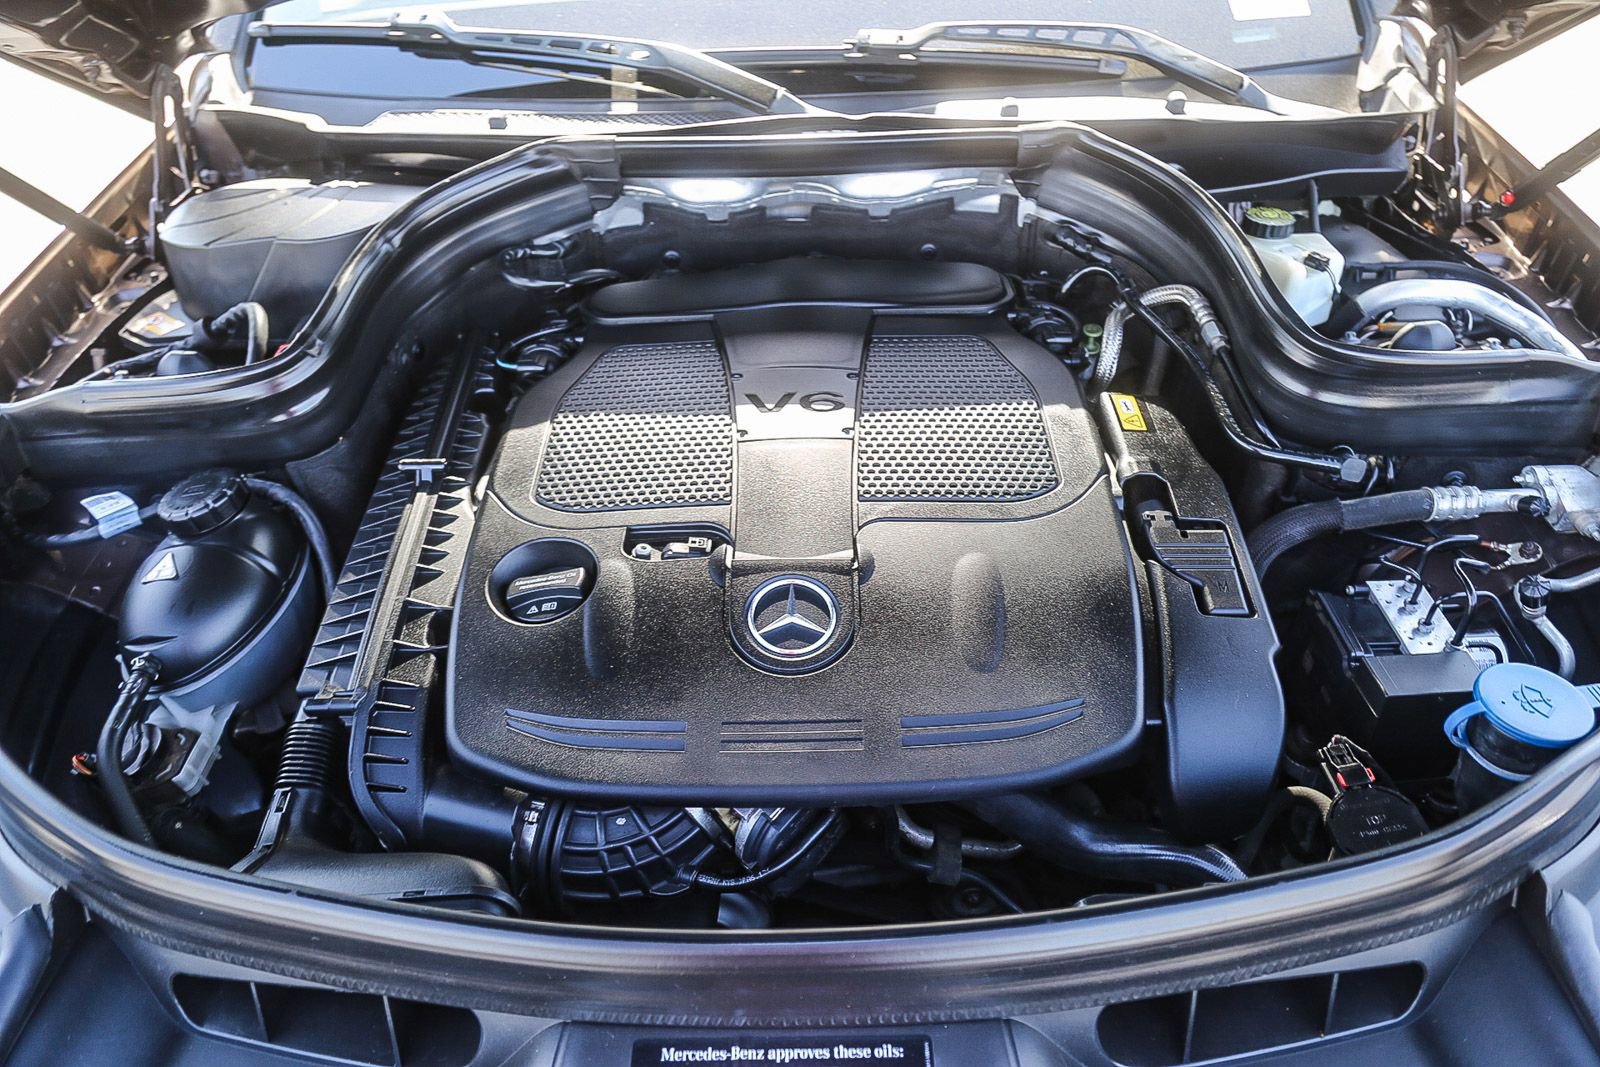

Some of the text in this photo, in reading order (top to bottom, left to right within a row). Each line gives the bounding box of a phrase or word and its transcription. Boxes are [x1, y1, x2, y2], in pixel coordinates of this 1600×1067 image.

[744, 392, 846, 413] V6
[660, 1046, 766, 1062] Mercedes-Benz
[767, 1048, 831, 1063] approves
[833, 1044, 872, 1060] these
[873, 1043, 905, 1059] oils:
